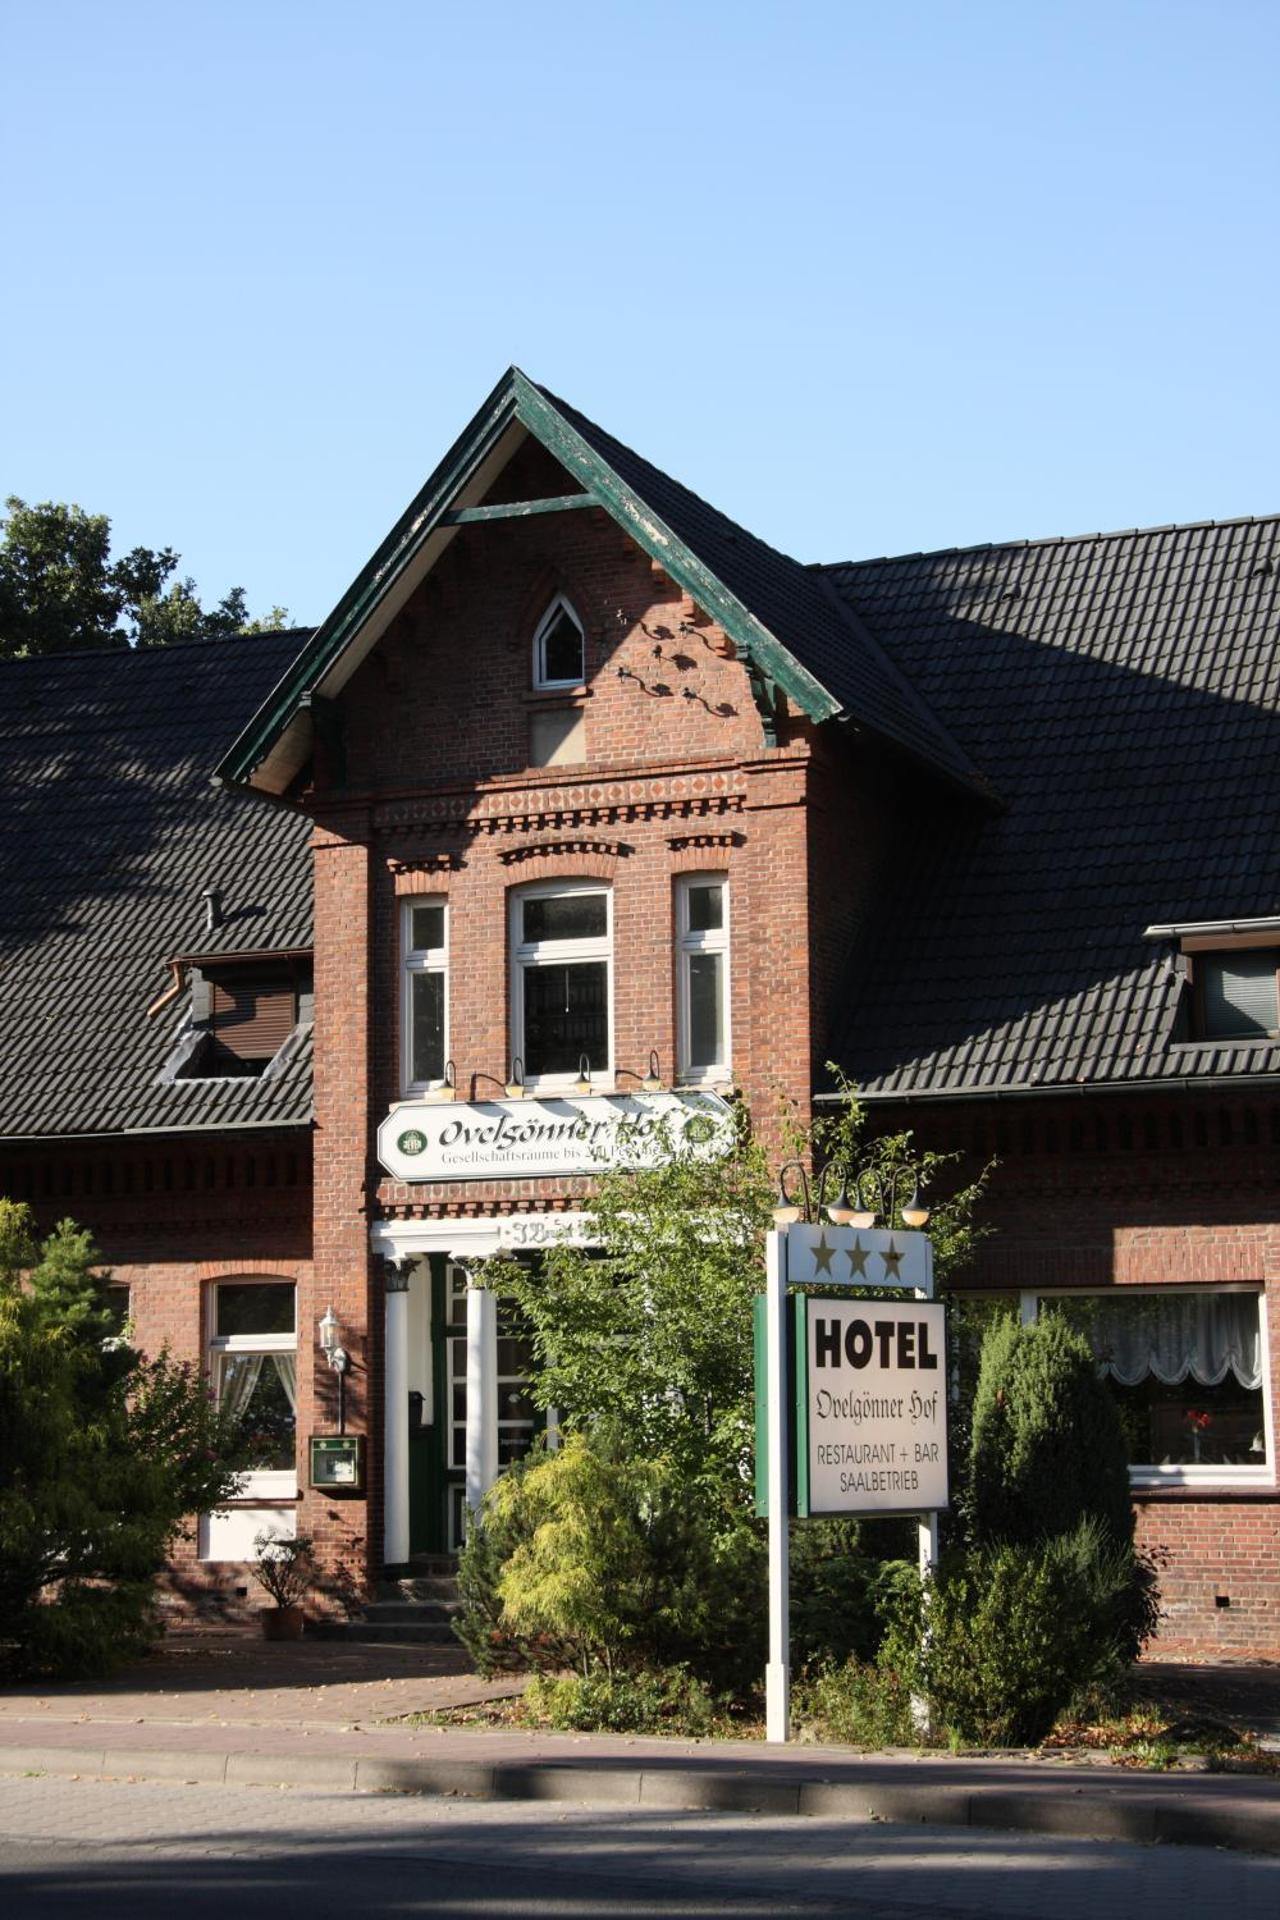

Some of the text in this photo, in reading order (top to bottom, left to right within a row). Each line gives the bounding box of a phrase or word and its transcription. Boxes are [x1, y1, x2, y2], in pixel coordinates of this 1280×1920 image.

[441, 1149, 560, 1165] Gesellschaftsräume
[563, 1146, 581, 1159] bis
[815, 1318, 938, 1370] HOTEL
[816, 1388, 938, 1426] Ovelgönner Hof
[817, 1443, 896, 1465] RESTAURANT
[914, 1443, 939, 1463] BAR
[840, 1470, 919, 1492] SAALBETRIEB
